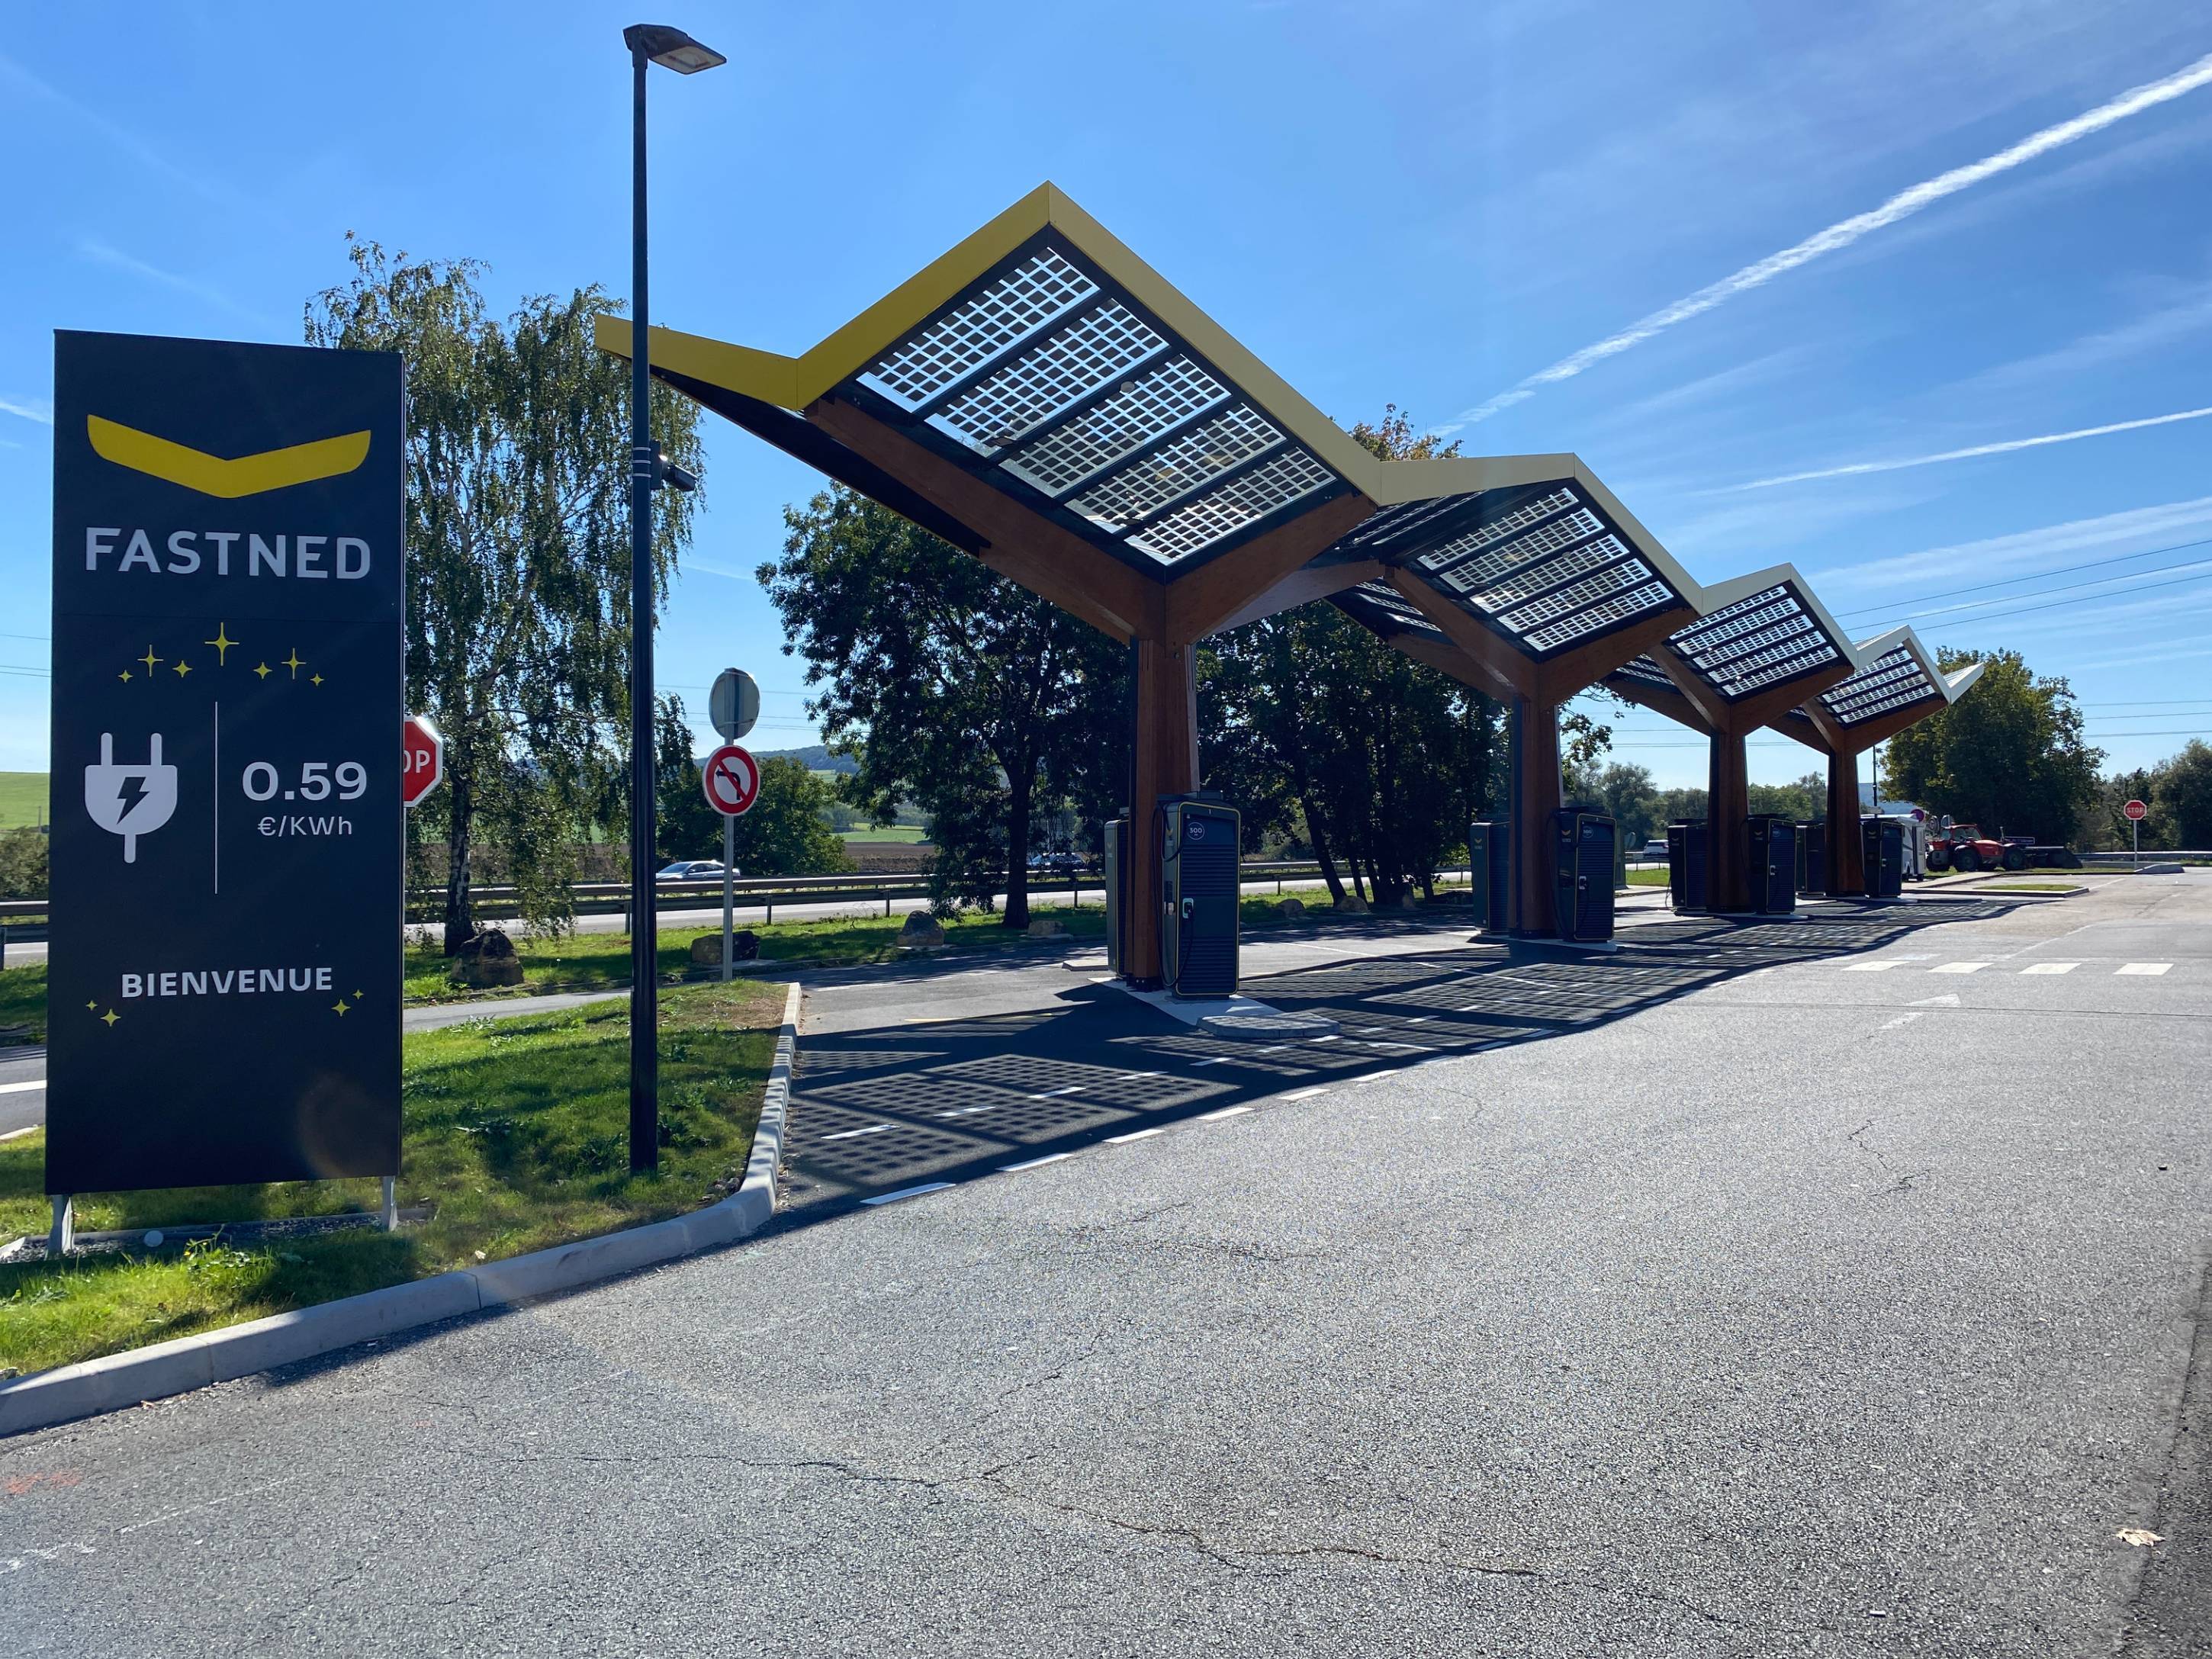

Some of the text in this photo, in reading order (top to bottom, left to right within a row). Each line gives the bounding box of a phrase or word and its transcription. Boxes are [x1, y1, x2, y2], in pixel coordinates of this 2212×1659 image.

[86, 527, 371, 580] FASTNED
[242, 761, 368, 801] 0.59
[257, 815, 353, 838] €/KWh
[121, 967, 333, 998] BIENVENUE
